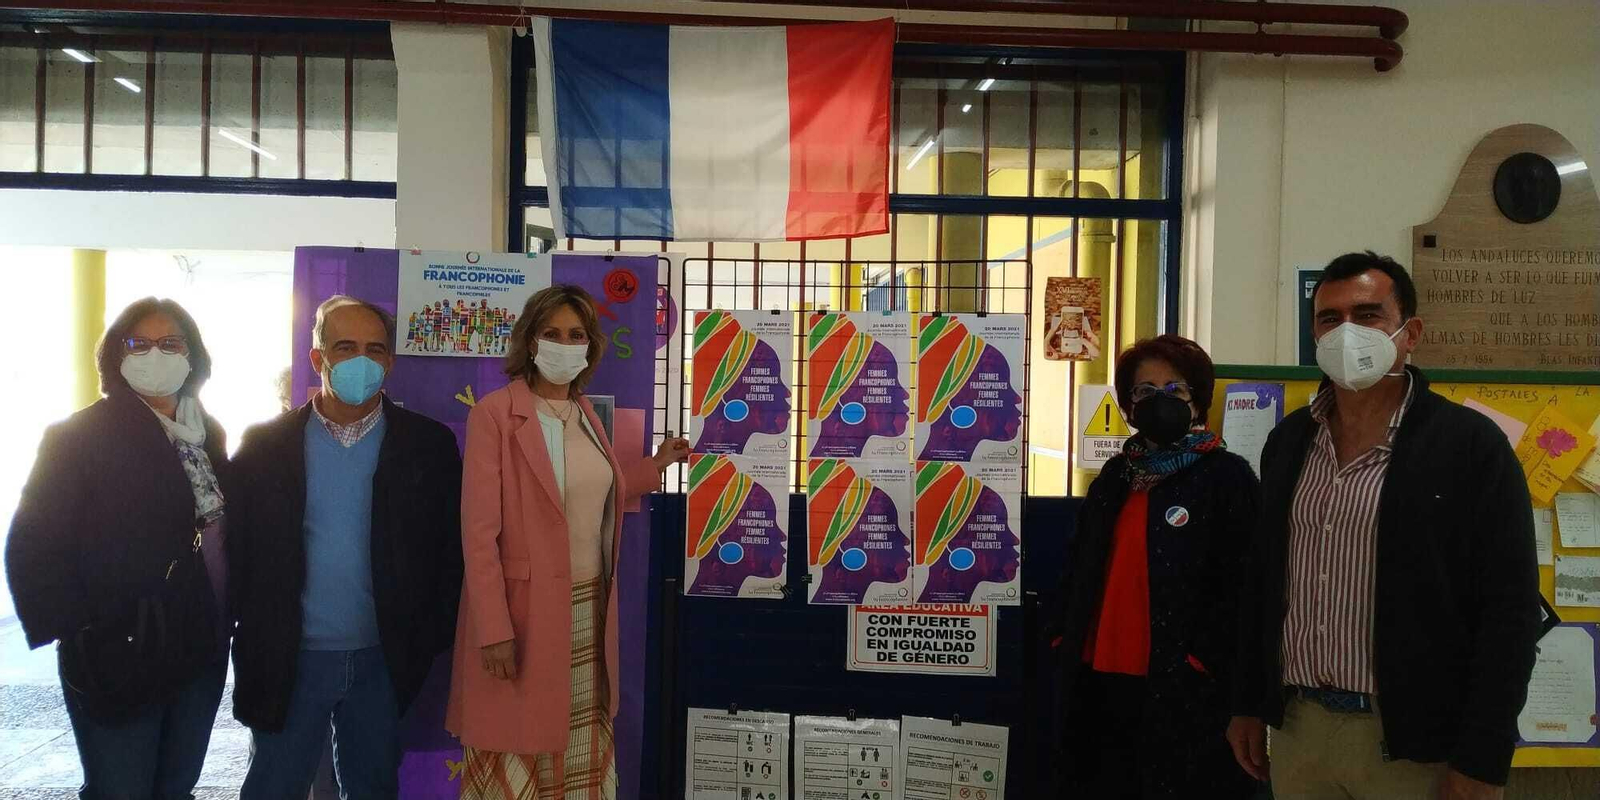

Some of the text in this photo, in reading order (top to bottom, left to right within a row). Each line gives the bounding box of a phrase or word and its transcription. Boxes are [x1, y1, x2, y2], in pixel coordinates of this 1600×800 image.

[1442, 249, 1464, 263] LOS
[1470, 250, 1540, 264] ANDALUCES
[423, 269, 526, 285] FRANCOPHONIE
[1432, 269, 1479, 283] VOLVER
[1485, 271, 1493, 284] A
[1499, 271, 1521, 284] SER
[1526, 271, 1541, 285] LO
[1545, 271, 1569, 285] QUE
[1427, 289, 1536, 304] HOMBRES DE LUZ
[1490, 312, 1512, 326] QUE
[1521, 313, 1529, 326] A
[1537, 313, 1557, 327] LOS
[1422, 331, 1465, 345] ALMAS
[1473, 332, 1486, 345] DE
[1495, 332, 1550, 347] HOMBRES
[1558, 333, 1579, 347] LES
[742, 376, 778, 384] FRANCOPHONES
[859, 378, 896, 386] FRANCOPHONES
[970, 382, 1008, 390] FRANCOPHONES
[978, 391, 999, 399] FEMMES
[1449, 385, 1590, 406] Y POSTALES A LA
[1233, 398, 1255, 411] MADRE
[1093, 440, 1120, 449] FUERA DE
[738, 519, 774, 527] FRANCOPHONES
[859, 524, 896, 532] FRANCOPHONES
[968, 523, 1006, 531] FRANCOPHONES
[746, 528, 765, 536] FEMMES
[868, 614, 971, 628] CON FUERTE
[866, 626, 977, 641] COMPROMISO
[866, 639, 975, 653] EN IGUALDAD
[876, 650, 970, 665] DE GÉNERO
[703, 714, 745, 724] RECOMENDACIONES
[909, 732, 965, 745] RECOMENDACIONES
[974, 740, 1000, 750] TRABAJO
